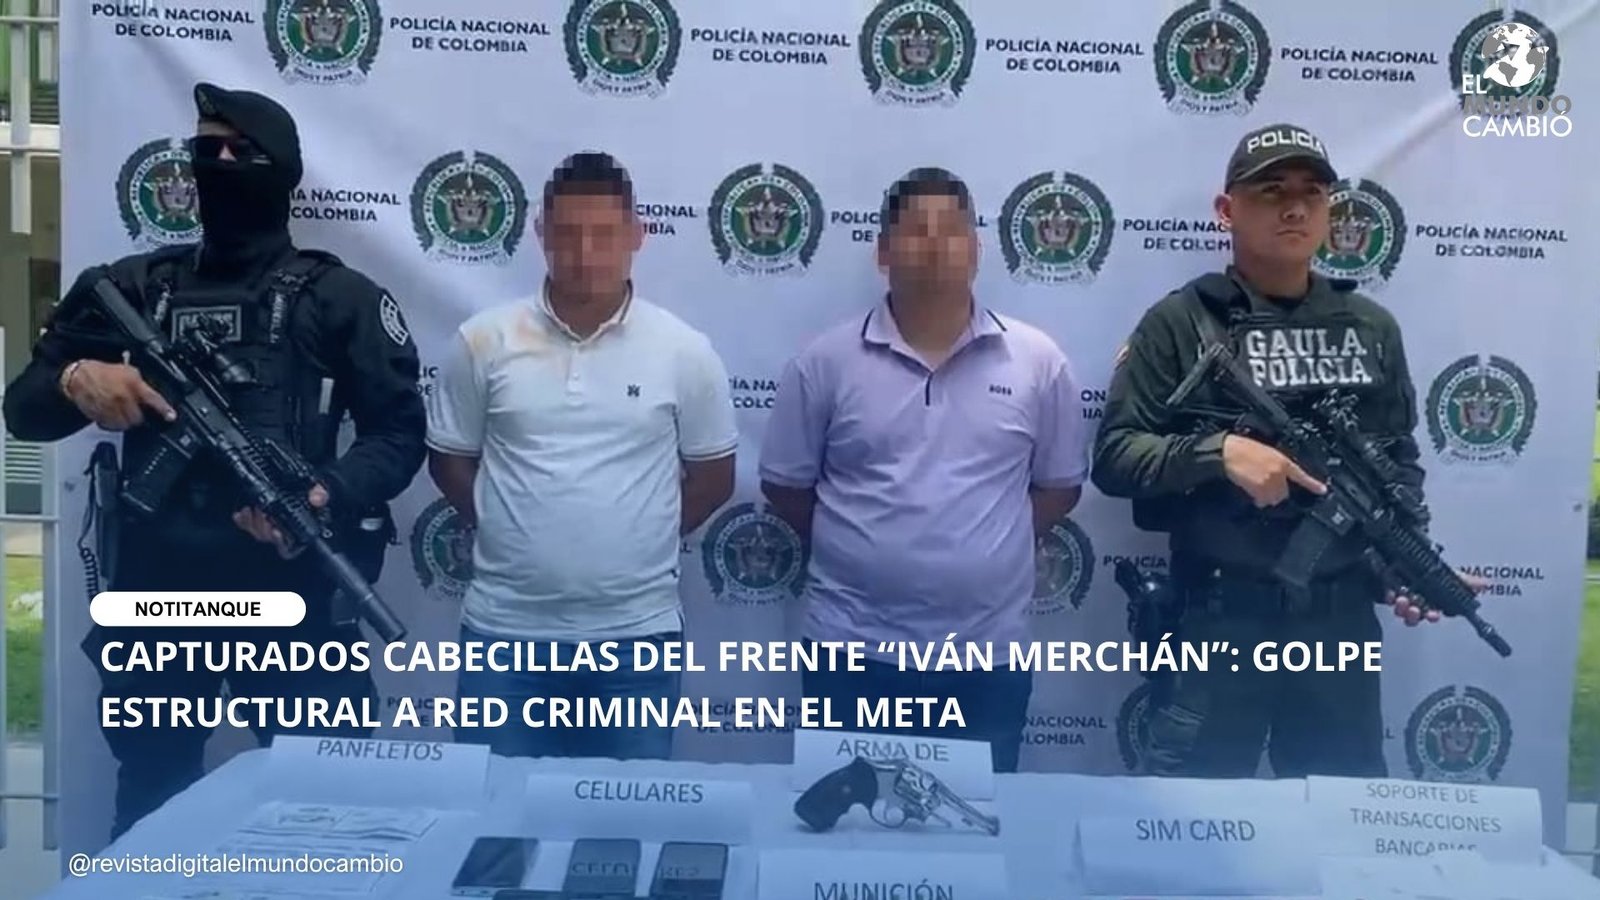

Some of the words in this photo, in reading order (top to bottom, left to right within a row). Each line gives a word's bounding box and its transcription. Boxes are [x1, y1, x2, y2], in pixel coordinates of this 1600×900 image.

[92, 3, 158, 20] POLICÍA
[165, 8, 255, 24] NACIONAL
[116, 23, 136, 36] DE
[141, 25, 233, 42] COLOMBIA
[390, 17, 456, 33] POLICÍA
[461, 20, 550, 35] NACIONAL
[412, 37, 434, 50] DE
[439, 38, 527, 53] COLOMBIA
[690, 28, 758, 43] POLICÍA
[762, 31, 851, 47] NACIONAL
[985, 38, 1051, 53] POLICÍA
[1057, 40, 1144, 55] NACIONAL
[713, 48, 733, 61] DE
[739, 49, 828, 65] COLOMBIA
[1281, 46, 1346, 62] POLICÍA
[1351, 50, 1439, 65] NACIONAL
[1006, 58, 1028, 71] DE
[1033, 59, 1121, 74] COLOMBIA
[1302, 67, 1322, 80] DE
[1327, 68, 1415, 83] COLOMBIA
[311, 189, 401, 206] NACIONAL
[291, 206, 377, 222] COLOMBIA
[1123, 219, 1189, 234] POLICÍA
[1415, 224, 1479, 240] POLICÍA
[1484, 227, 1568, 242] NACIONAL
[852, 229, 874, 243] DE
[1144, 238, 1166, 251] DE
[1435, 243, 1456, 256] DE
[1461, 245, 1545, 259] COLOMBIA
[1247, 328, 1367, 358] GAULA
[1249, 357, 1372, 387] POLICIA
[317, 739, 443, 761] PANFLETOS
[837, 739, 908, 758] ARMA
[915, 743, 949, 762] DE
[574, 779, 704, 804] CELULARES
[1366, 783, 1449, 802] SOPORTE
[1455, 789, 1479, 804] DE
[1350, 808, 1502, 833] TRANSACCIONES
[1136, 820, 1181, 842] SIM
[1189, 819, 1256, 842] CARD
[814, 877, 953, 900] MUNICIÓN
